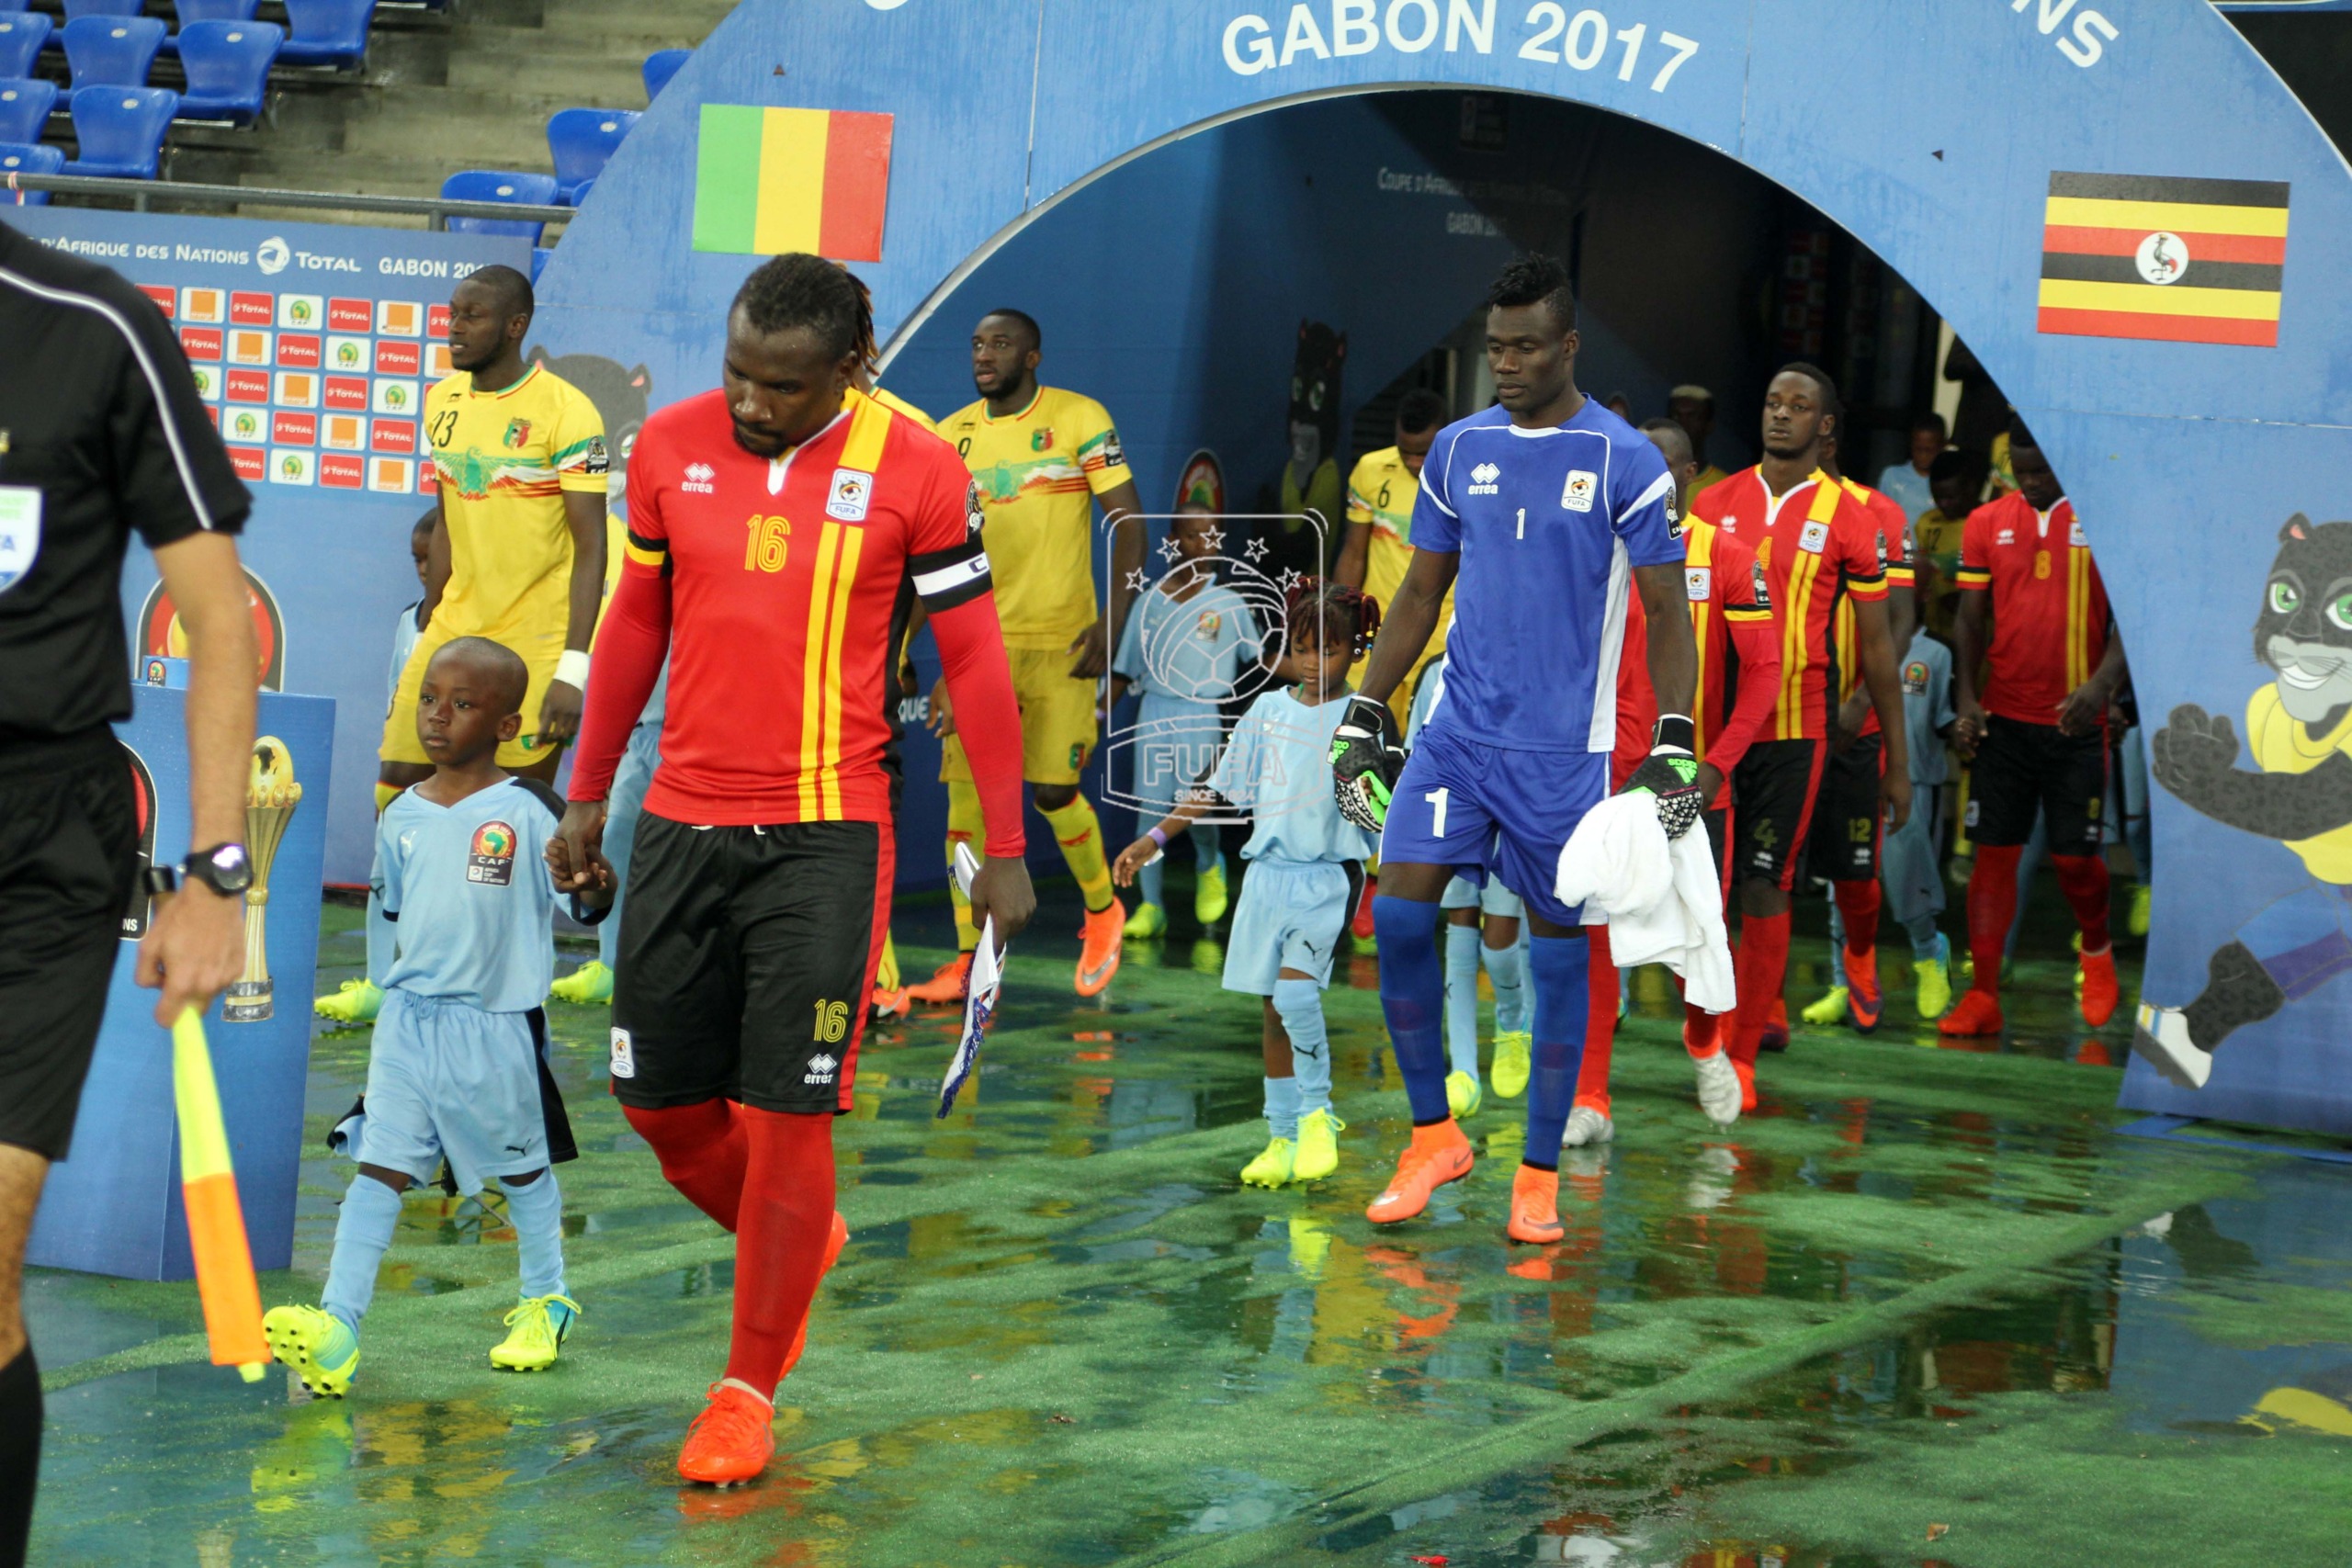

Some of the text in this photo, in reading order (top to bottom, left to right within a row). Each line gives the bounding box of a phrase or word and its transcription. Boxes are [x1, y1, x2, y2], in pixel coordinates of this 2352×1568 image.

[1222, 0, 1700, 93] GABON 2017
[136, 244, 168, 260] DES
[175, 243, 249, 265] NATIONS
[295, 251, 362, 272] TOTAL
[379, 256, 447, 277] GABON
[453, 262, 491, 279] 20
[1378, 479, 1391, 509] 6
[1567, 498, 1586, 507] FUFA
[834, 505, 856, 515] FUFA
[1516, 508, 1526, 539] 1
[744, 514, 791, 573] 16
[1756, 536, 1773, 570] 4
[968, 558, 988, 573] C
[2034, 549, 2052, 580] 8
[1425, 787, 1451, 838] 1
[1754, 818, 1778, 849] 4
[1849, 818, 1871, 842] 12
[478, 856, 505, 865] CAF
[813, 998, 848, 1043] 16
